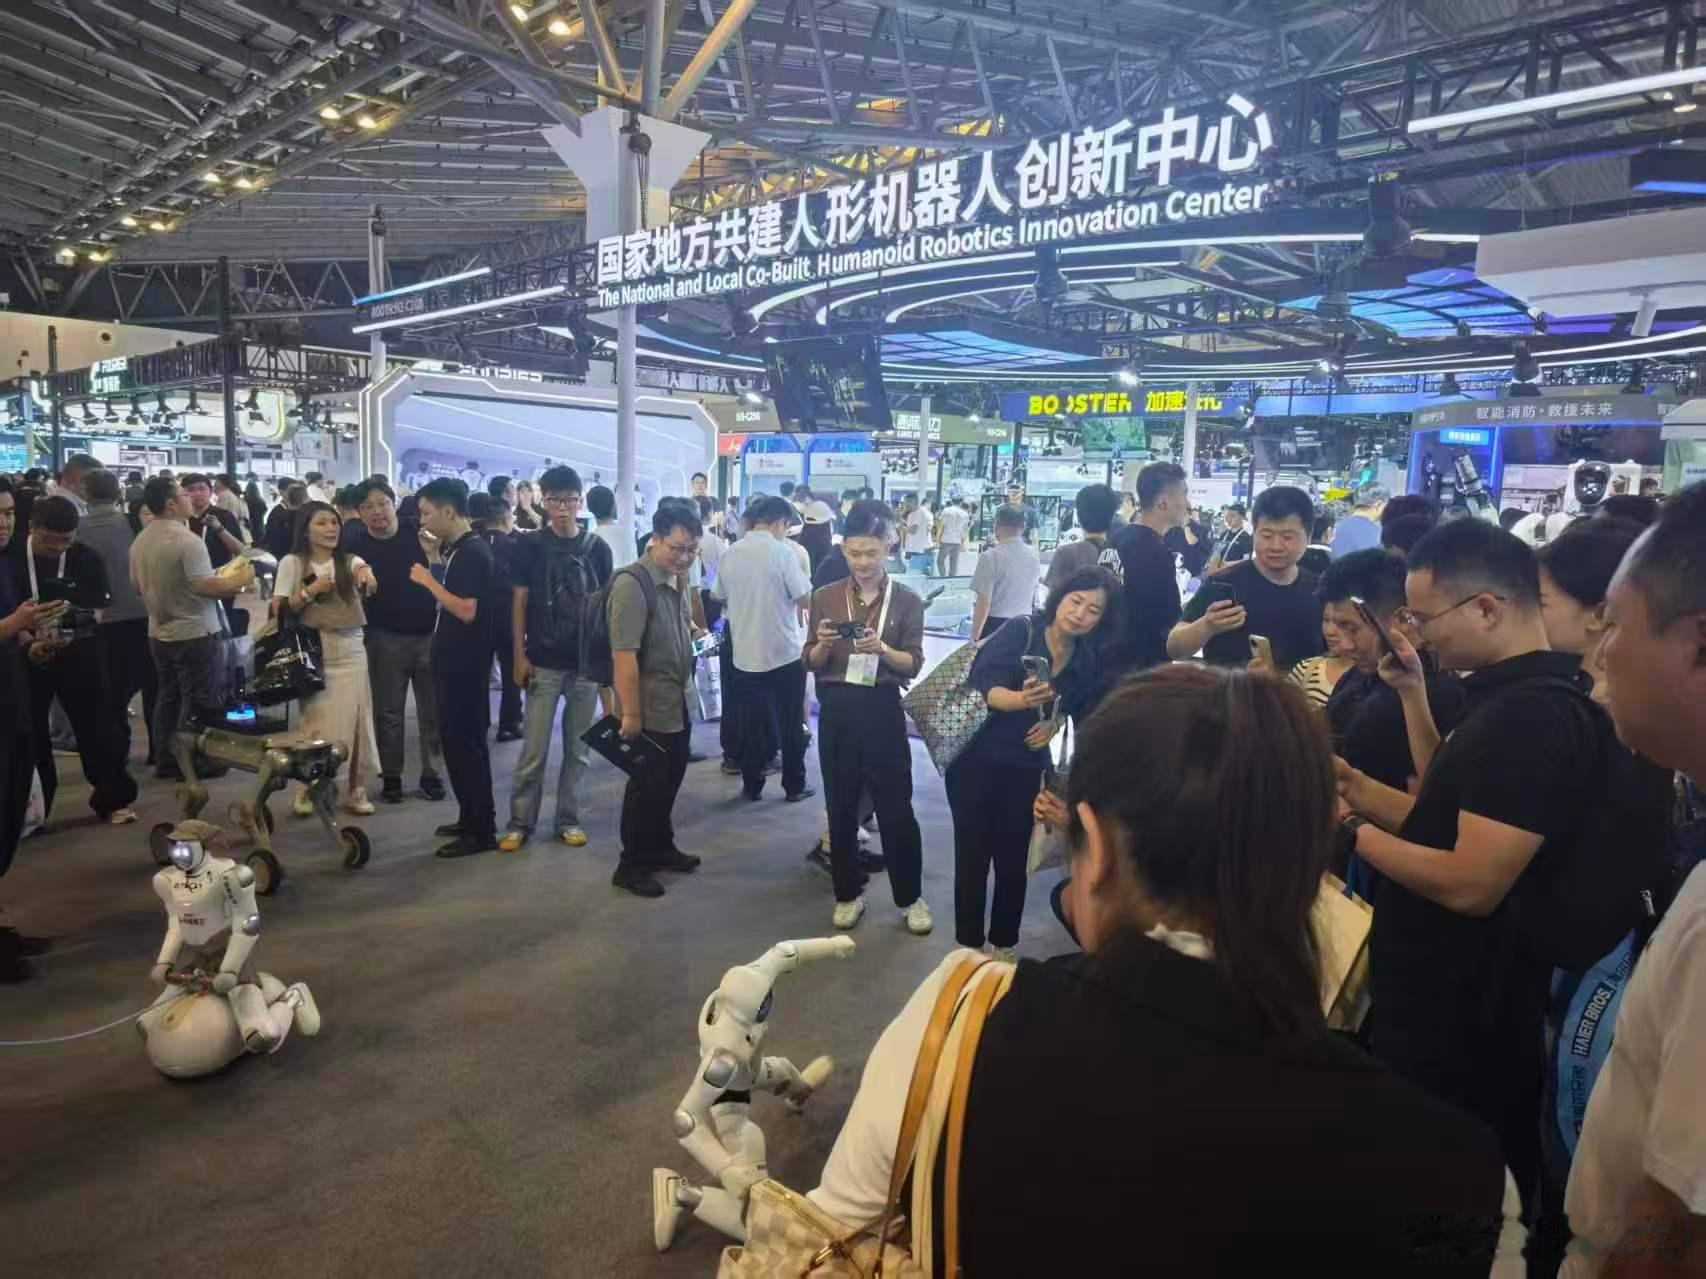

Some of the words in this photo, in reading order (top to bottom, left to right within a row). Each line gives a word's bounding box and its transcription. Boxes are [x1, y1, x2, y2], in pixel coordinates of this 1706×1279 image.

[598, 93, 1274, 287] 国家地方共建人形机器人创新中心
[598, 288, 620, 308] The
[621, 277, 674, 306] National
[676, 276, 702, 299] and
[705, 270, 743, 296] Local
[746, 258, 811, 288] Co-Built
[817, 236, 916, 276] Humanoid
[920, 223, 1013, 261] Robotics
[1019, 200, 1158, 245] Innovation
[1165, 182, 1269, 220] Center
[1574, 1020, 1597, 1056] HAIER
